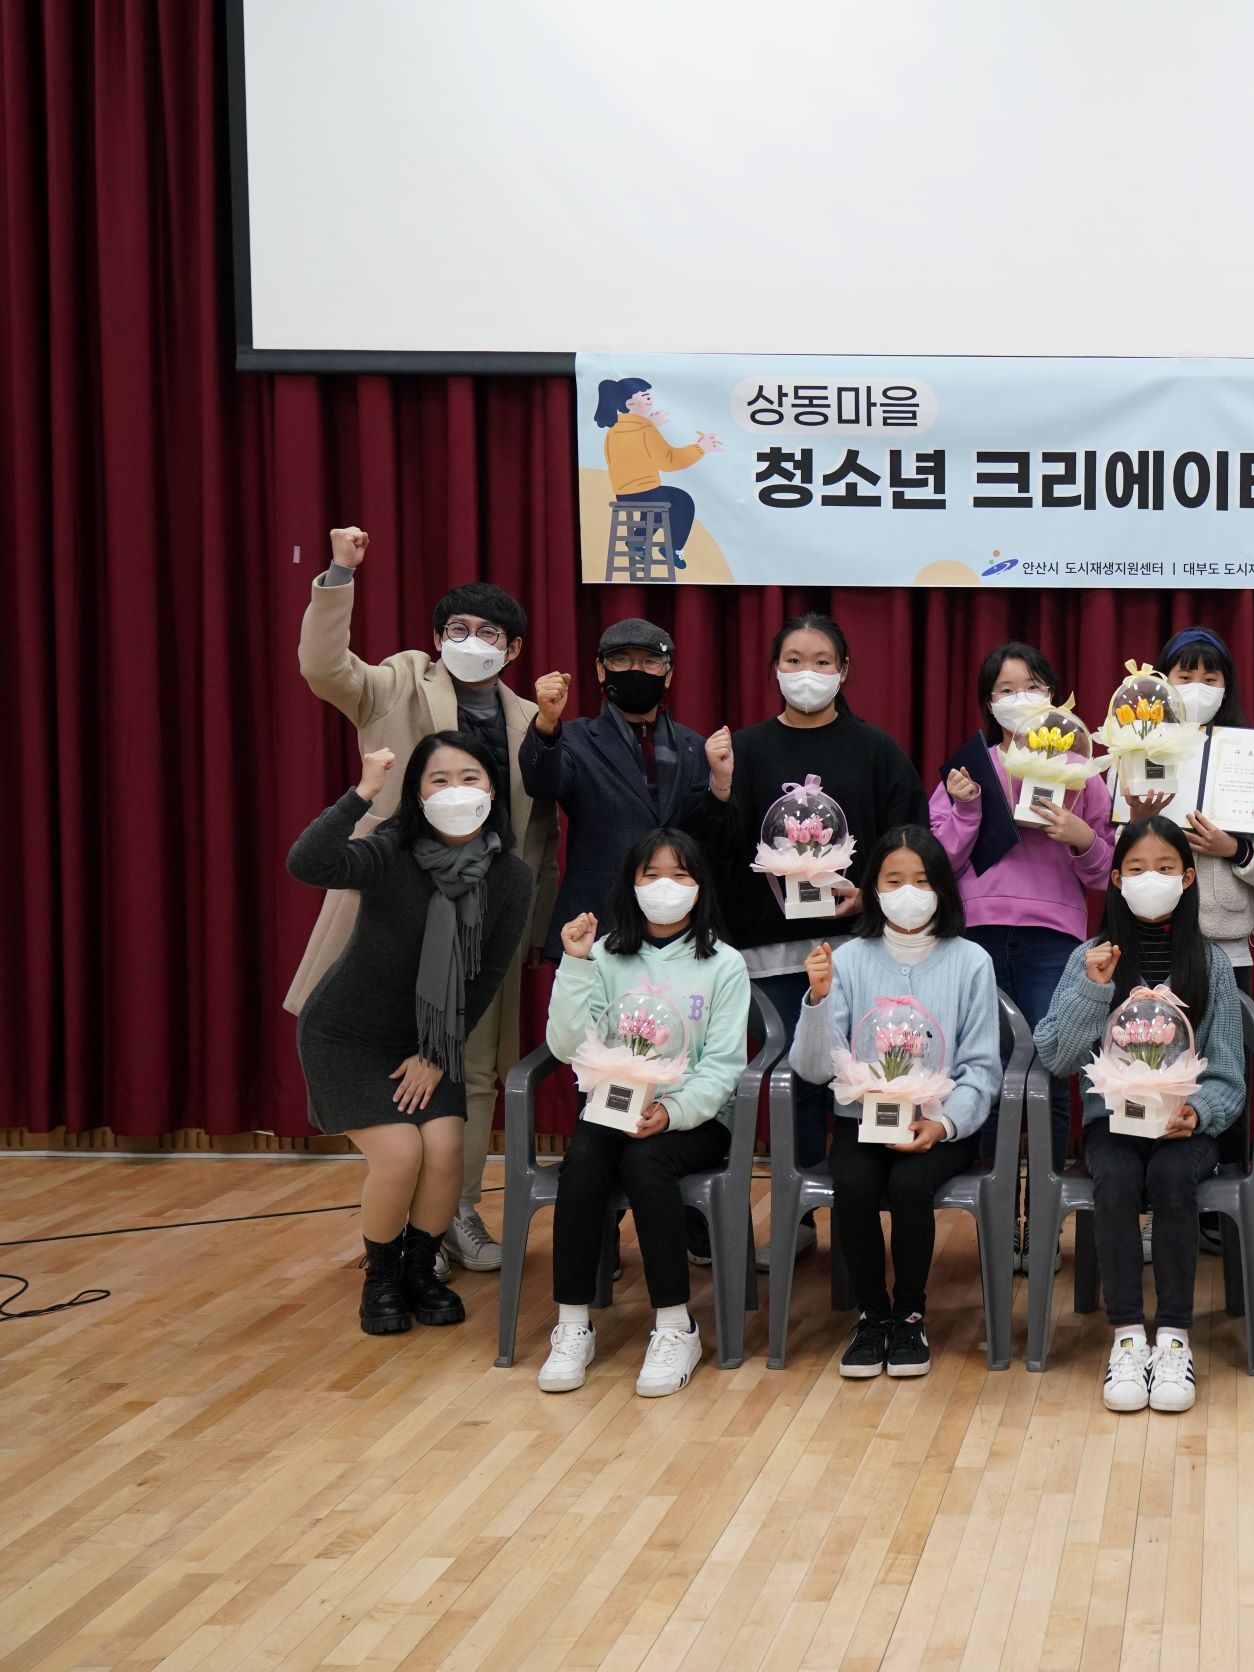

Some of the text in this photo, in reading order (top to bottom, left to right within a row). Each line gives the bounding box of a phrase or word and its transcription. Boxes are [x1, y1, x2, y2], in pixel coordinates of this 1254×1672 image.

[747, 384, 920, 427] 상동마을
[755, 446, 947, 510] 청소년
[1022, 561, 1164, 576] 안산시 도시재생지원센터
[1183, 562, 1220, 576] 대부도
